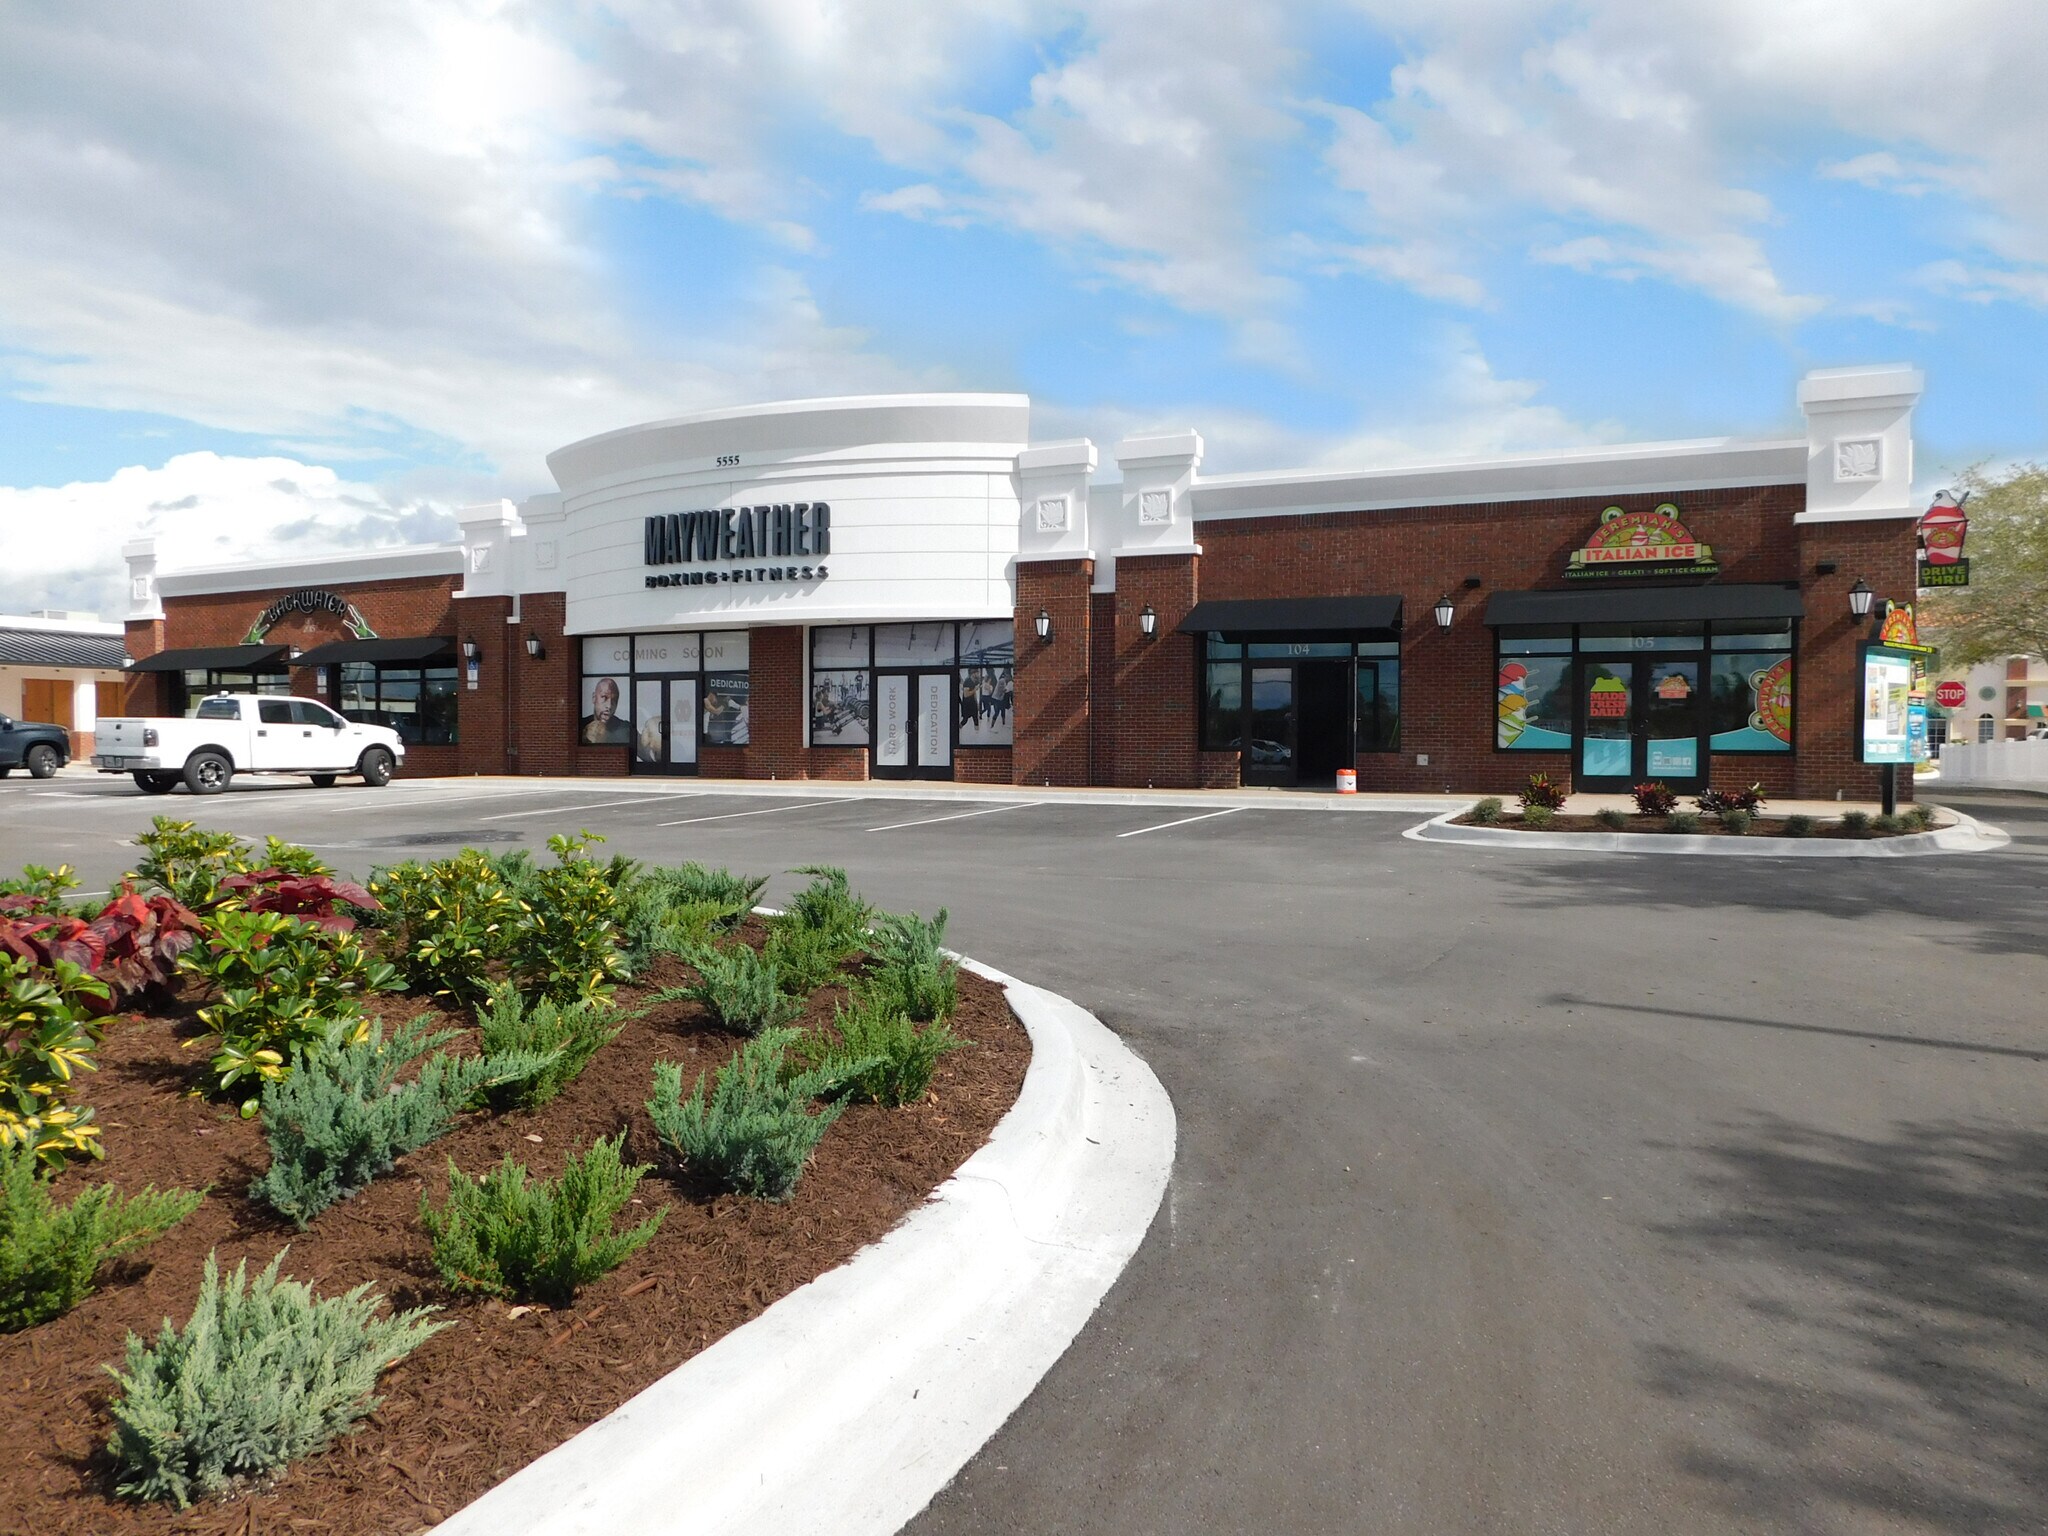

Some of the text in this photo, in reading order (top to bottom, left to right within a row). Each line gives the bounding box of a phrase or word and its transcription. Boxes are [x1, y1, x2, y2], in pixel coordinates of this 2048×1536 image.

[716, 455, 740, 467] 5555
[644, 502, 831, 565] MAYWEATHER
[1596, 514, 1685, 543] JEREMIAH'S
[1585, 545, 1695, 562] ITALIAN ICE
[1564, 571, 1595, 579] ITALIAN
[1690, 566, 1718, 574] CREAM
[1921, 565, 1966, 576] DRIVE
[1922, 575, 1965, 586] THRU
[268, 589, 348, 622] BACKWATER
[613, 646, 723, 662] COMING SOON
[1287, 643, 1310, 655] 104
[710, 678, 749, 690] DEDICATIO
[1590, 692, 1627, 700] MADE
[1936, 689, 1965, 700] STOP
[1590, 700, 1627, 708] FRESH
[1590, 708, 1627, 717] DAILY
[888, 686, 897, 755] HARD WORK
[930, 685, 938, 755] DEDICATION
